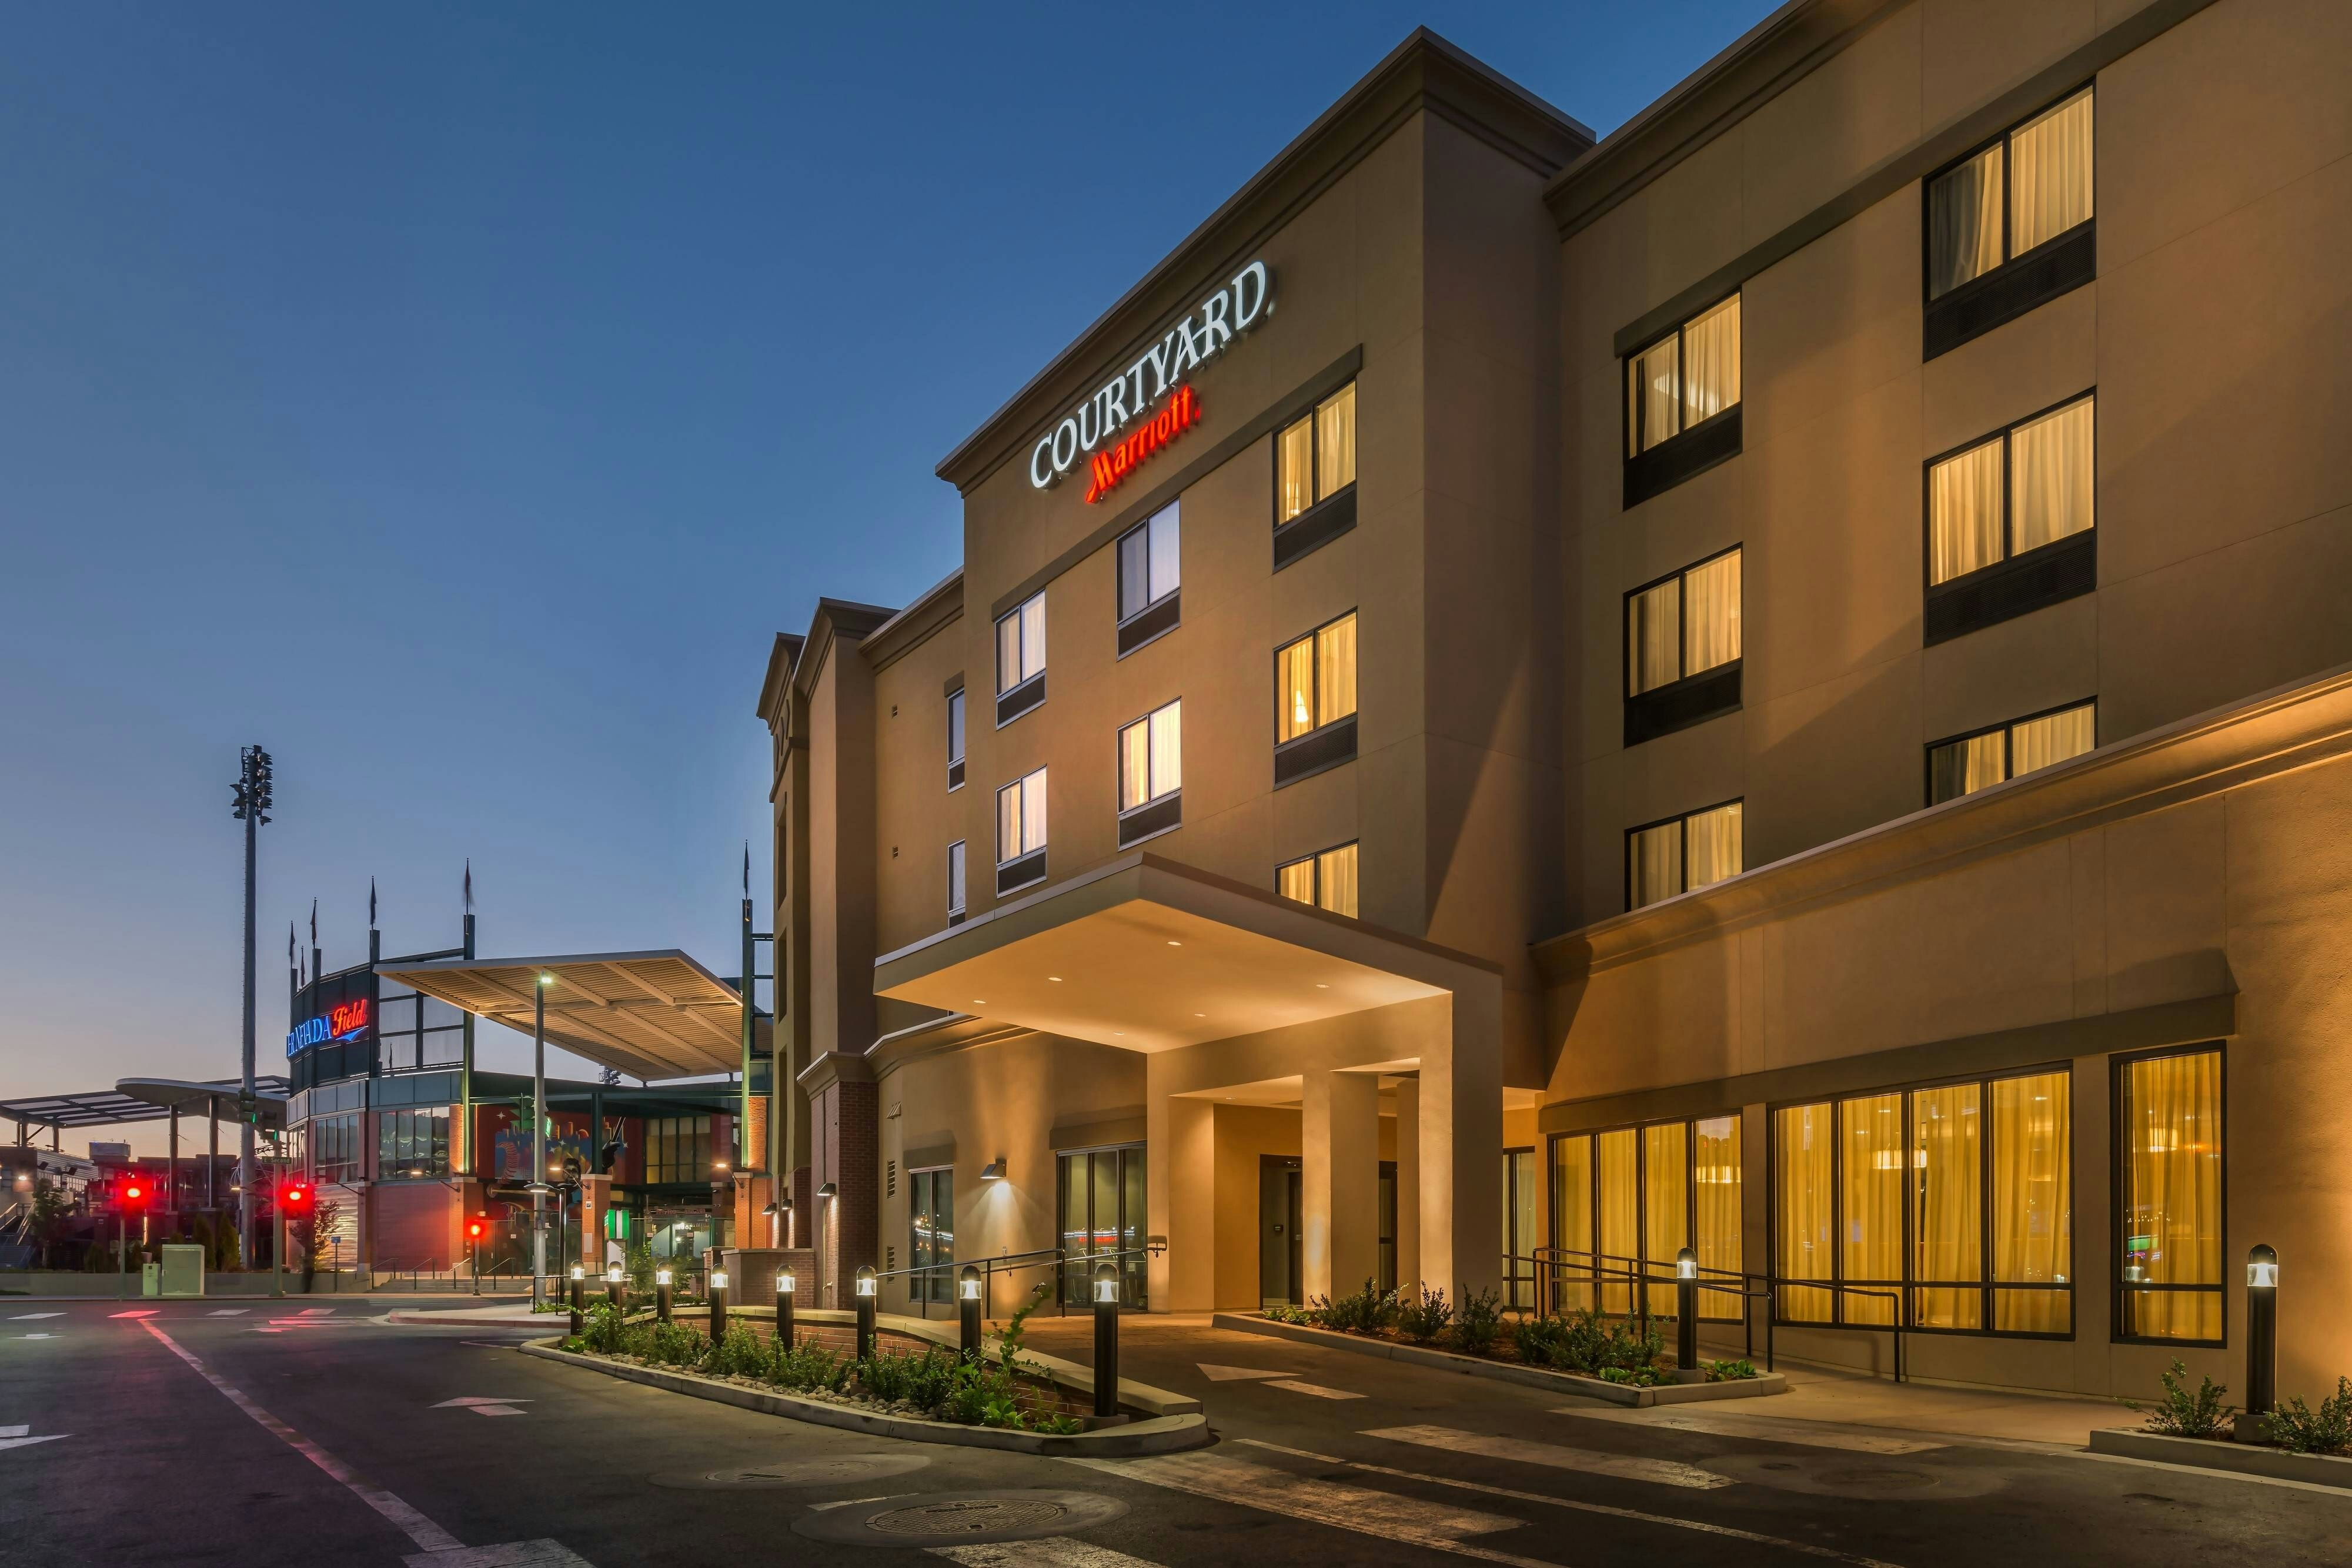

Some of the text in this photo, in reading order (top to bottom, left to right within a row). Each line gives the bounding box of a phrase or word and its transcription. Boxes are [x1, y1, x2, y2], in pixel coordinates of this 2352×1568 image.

[1031, 262, 1267, 489] COURTYARD
[1085, 386, 1194, 503] Marriott
[295, 1015, 332, 1051] NEVADA
[333, 999, 368, 1036] Field
